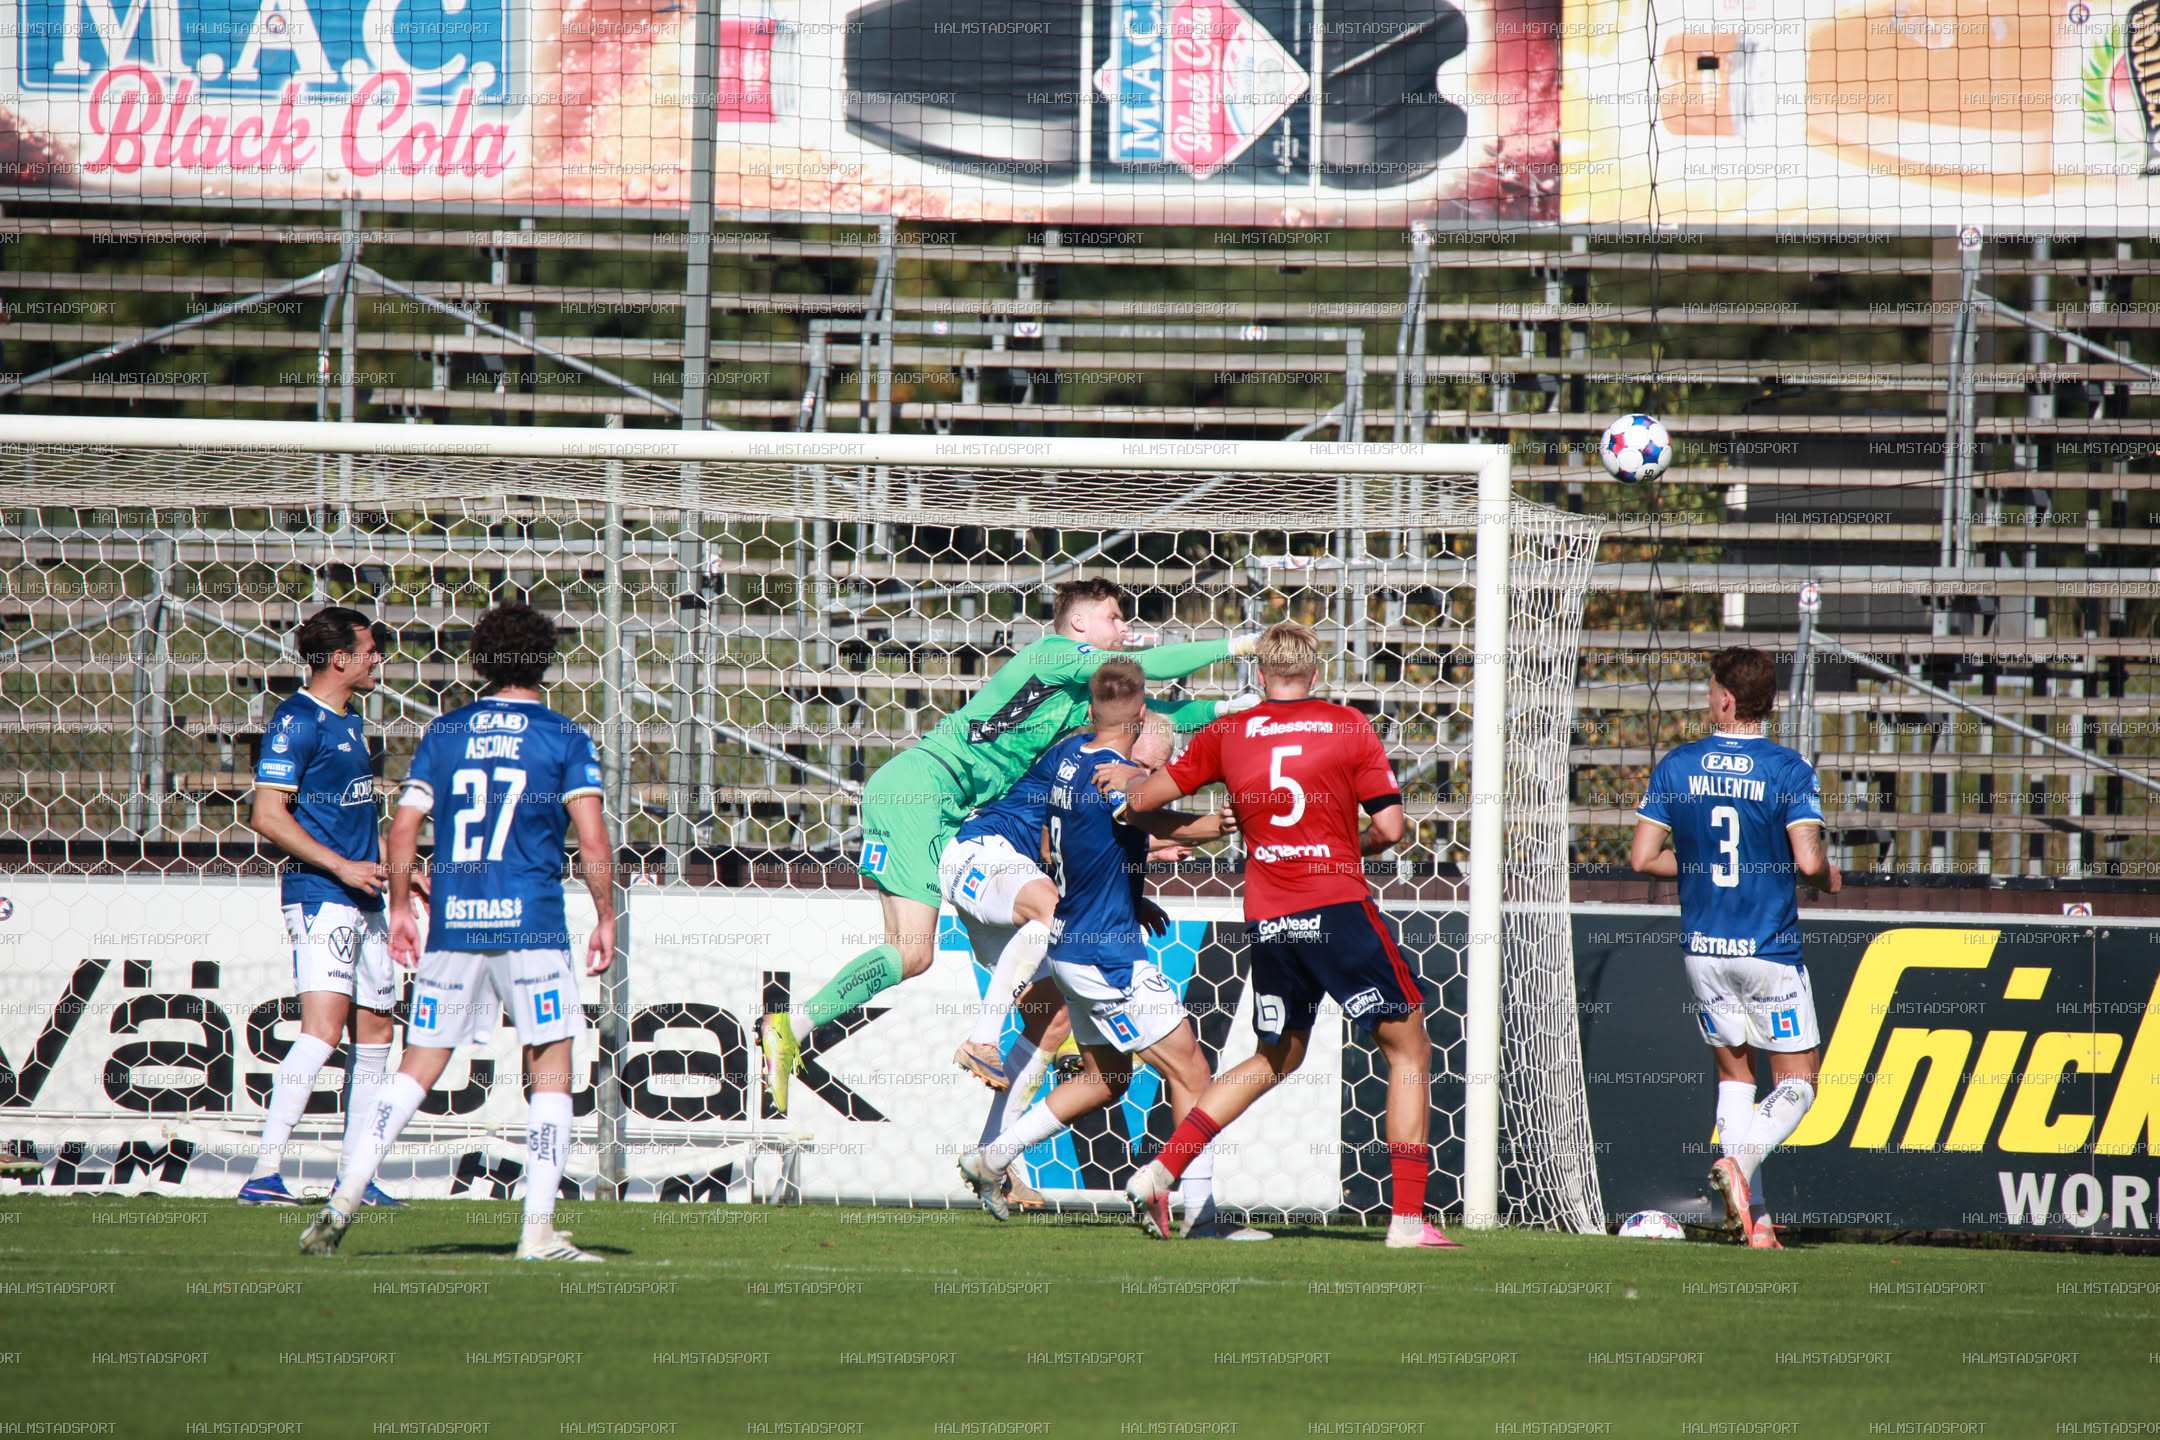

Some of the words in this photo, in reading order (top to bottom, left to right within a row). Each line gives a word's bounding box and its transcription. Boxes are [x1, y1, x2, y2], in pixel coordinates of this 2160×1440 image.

[85, 65, 317, 174] Black
[340, 70, 516, 178] Cola
[476, 712, 523, 730] EAB
[464, 736, 524, 760] ASCONE
[1706, 754, 1750, 772] EAB
[1269, 745, 1306, 827] 5
[1688, 775, 1766, 802] WALLENTIN
[452, 766, 527, 862] 27
[1711, 805, 1740, 888] 3
[445, 895, 514, 920] ÖSTRAS
[1258, 913, 1322, 936] GoAhead
[1690, 931, 1749, 956] ÖSTRAS
[836, 962, 889, 1000] Transport
[866, 977, 883, 998] GN
[1012, 980, 1027, 998] GN
[0, 959, 889, 1122] Väsak
[529, 1129, 539, 1152] GN
[1998, 1171, 2160, 1231] WOR
